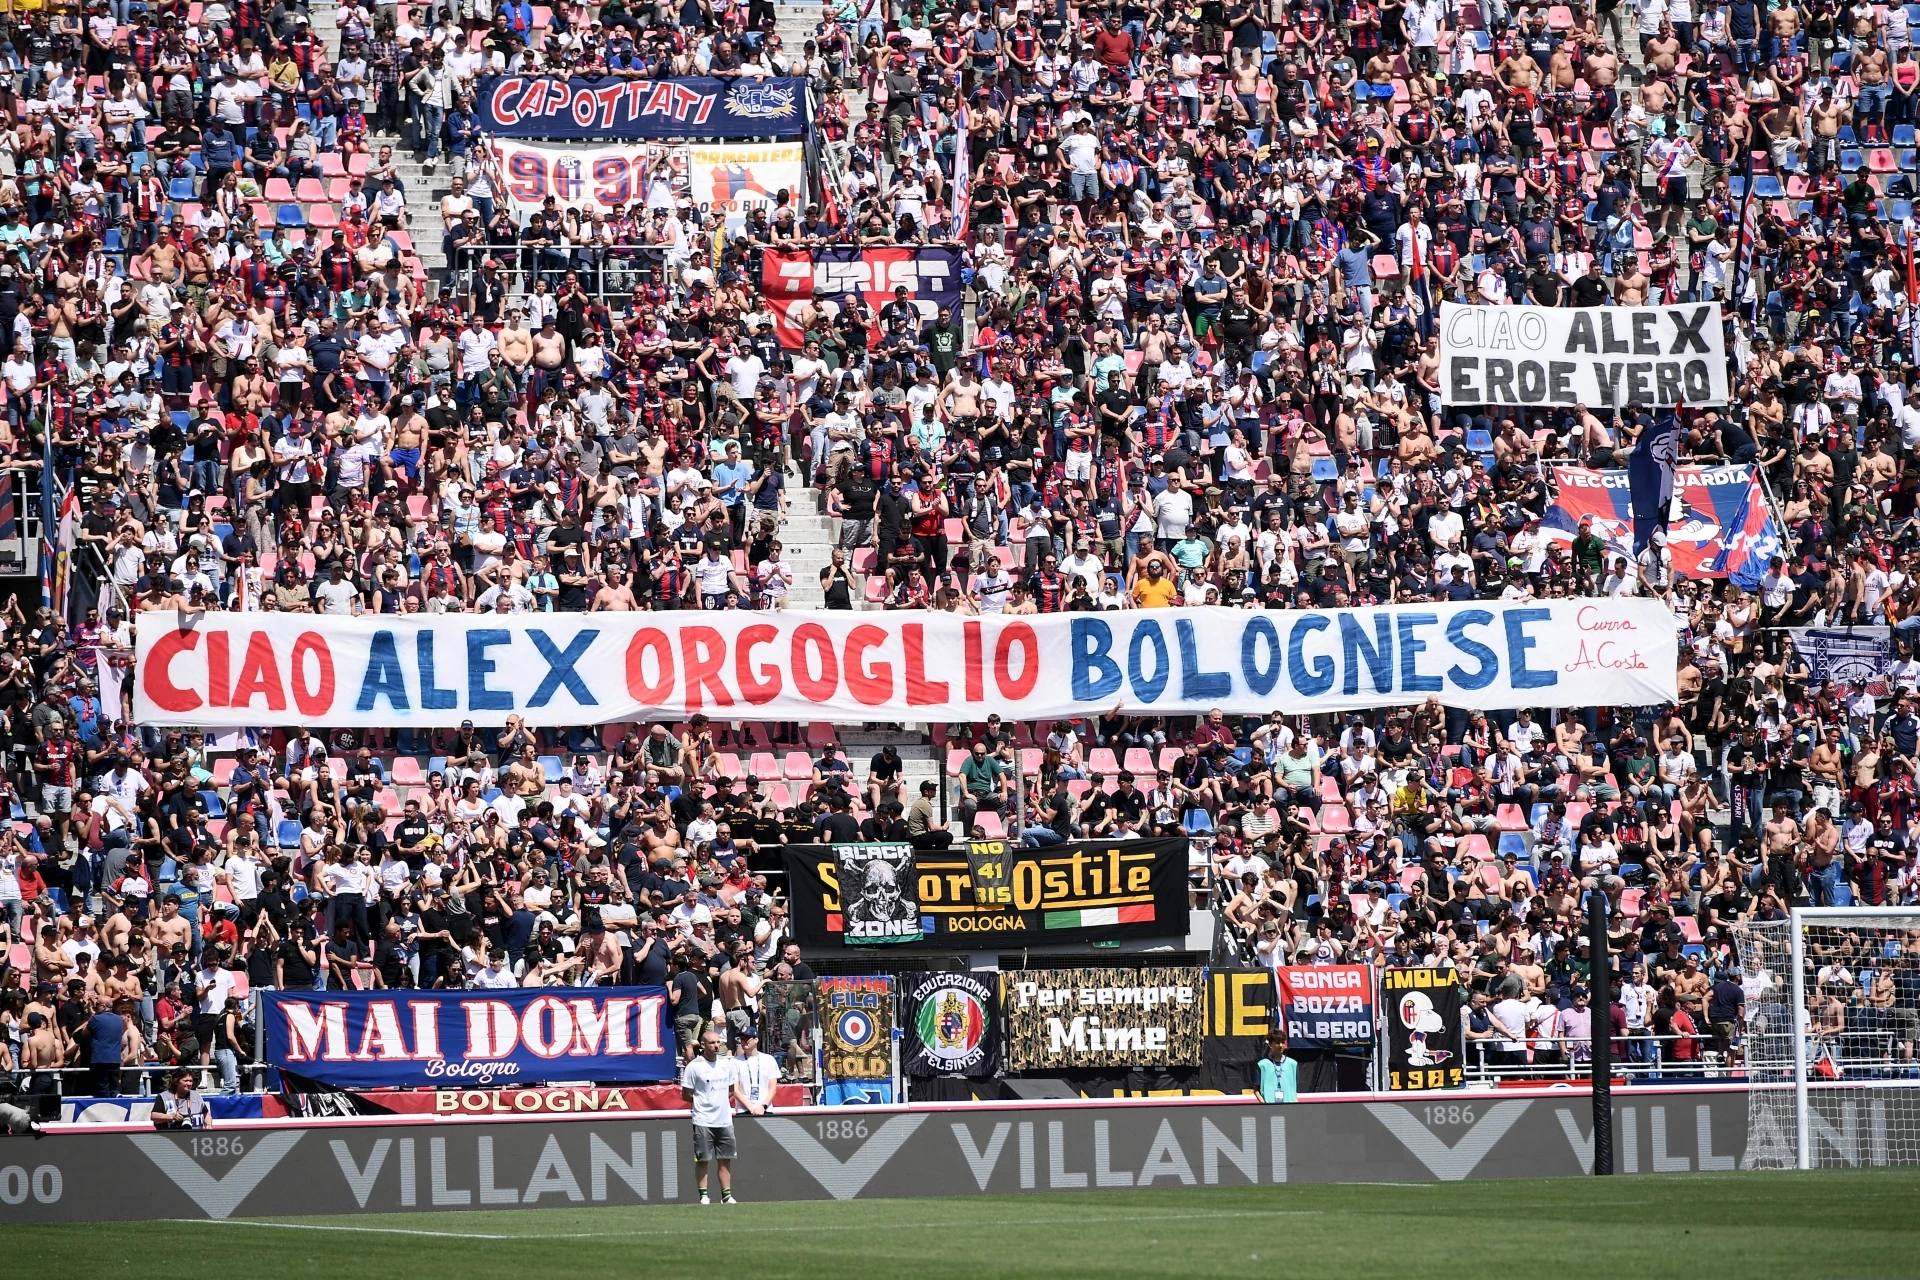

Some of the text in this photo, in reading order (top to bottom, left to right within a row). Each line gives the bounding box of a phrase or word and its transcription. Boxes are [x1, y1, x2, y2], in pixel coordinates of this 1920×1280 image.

[491, 78, 717, 129] CAPOTTATI
[690, 149, 804, 165] ORMENTERA
[743, 199, 768, 212] BLU
[779, 261, 950, 293] TURIST
[1447, 306, 1711, 356] CIAO ALEX
[1451, 356, 1711, 404] EROE VERO
[1558, 471, 1752, 489] VECCH UARDIA
[143, 608, 1558, 716] CIAO ALEX ORGOGLIO BOLOGNESE
[971, 842, 1004, 855] NO
[977, 863, 1002, 879] 41
[1013, 850, 1152, 911] Ostile
[849, 919, 919, 937] ZONE
[949, 915, 1026, 933] BOLOGNA
[912, 973, 992, 1002] EDUCAZIONE
[1289, 971, 1361, 989] SONGA
[831, 992, 878, 1008] FILA
[1016, 981, 1193, 1011] Per sempre
[1293, 995, 1363, 1014] BOZZA
[277, 994, 666, 1062] MAI DOMI
[1047, 1016, 1167, 1053] Mime
[1288, 1021, 1370, 1039] ALBERO
[828, 1056, 887, 1077] GOLD
[918, 1047, 985, 1071] FELSINEA
[424, 1058, 520, 1084] Bologna
[435, 1088, 630, 1112] BOLOGNA
[1424, 1105, 1475, 1126] 1886
[816, 1118, 869, 1139] 1886
[190, 1135, 244, 1157] 1886
[950, 1115, 1287, 1191] VILLANI
[329, 1130, 678, 1208] VILLANI
